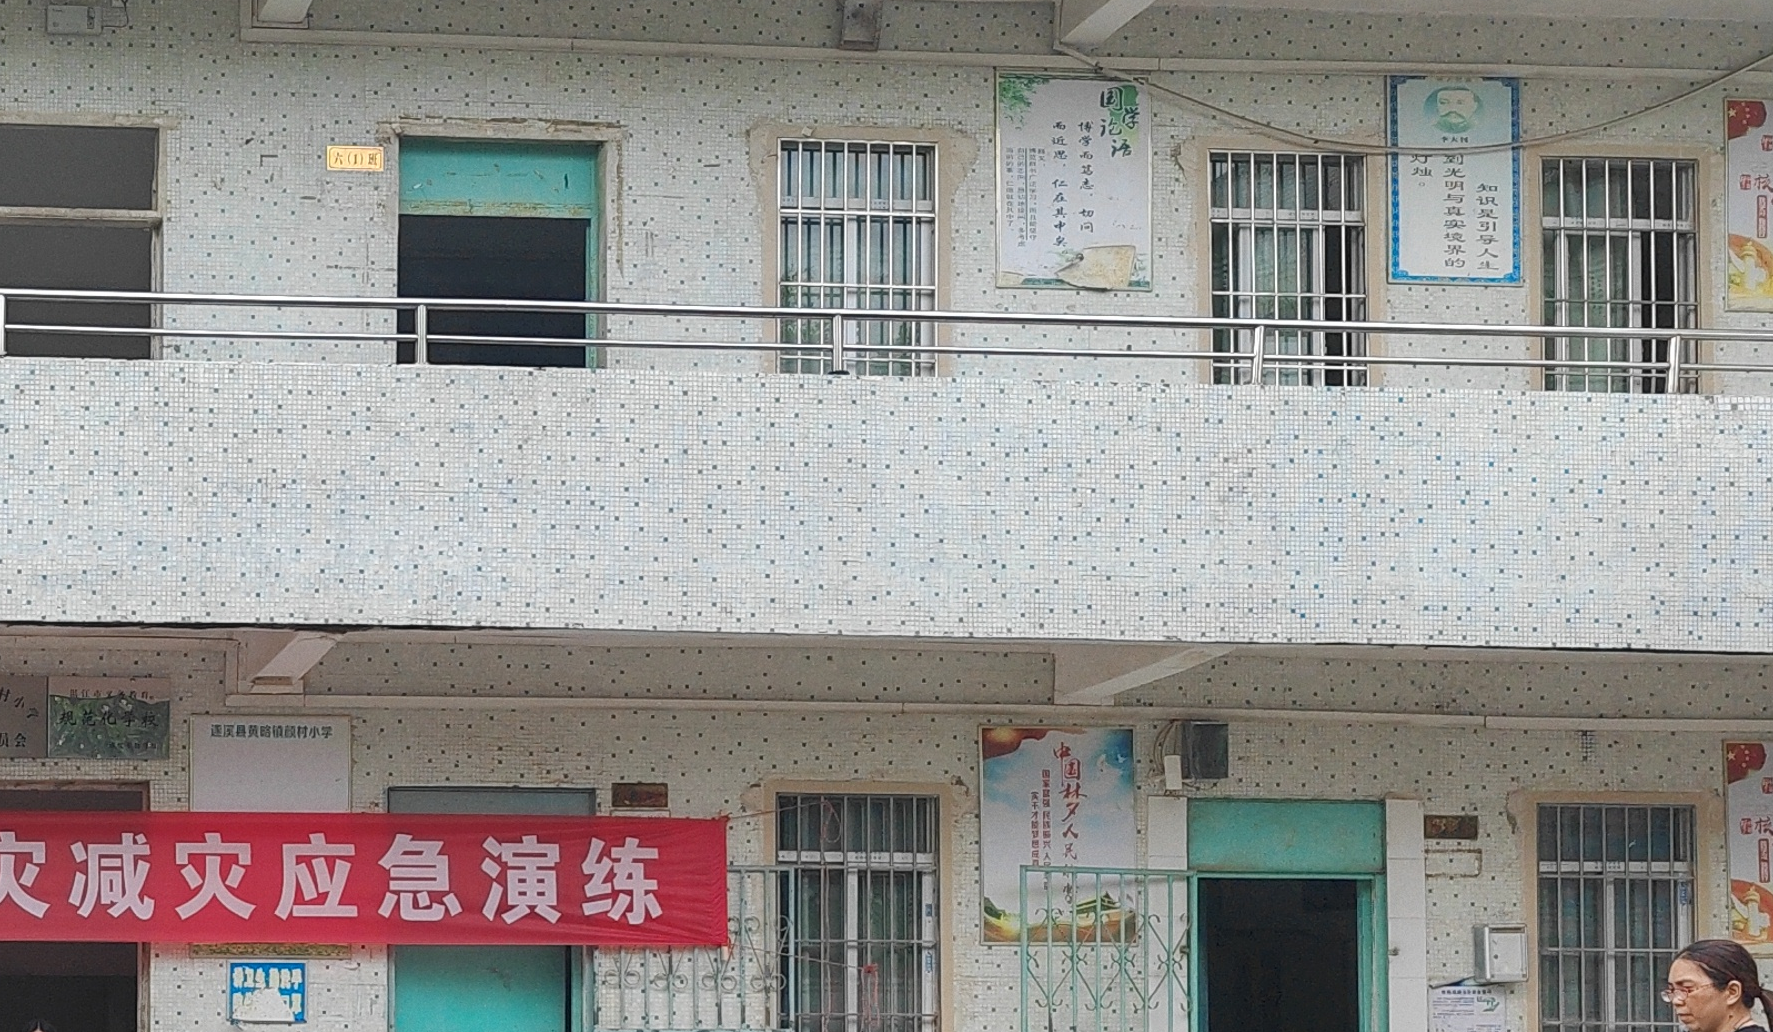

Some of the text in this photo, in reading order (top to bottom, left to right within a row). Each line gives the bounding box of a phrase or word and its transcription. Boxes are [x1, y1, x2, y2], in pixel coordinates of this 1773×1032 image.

[1100, 86, 1140, 158] 国学论语
[1443, 154, 1467, 268] 到光明与真实境界的
[1475, 182, 1499, 270] 知识是引导人生
[56, 709, 159, 728] 规范化学校
